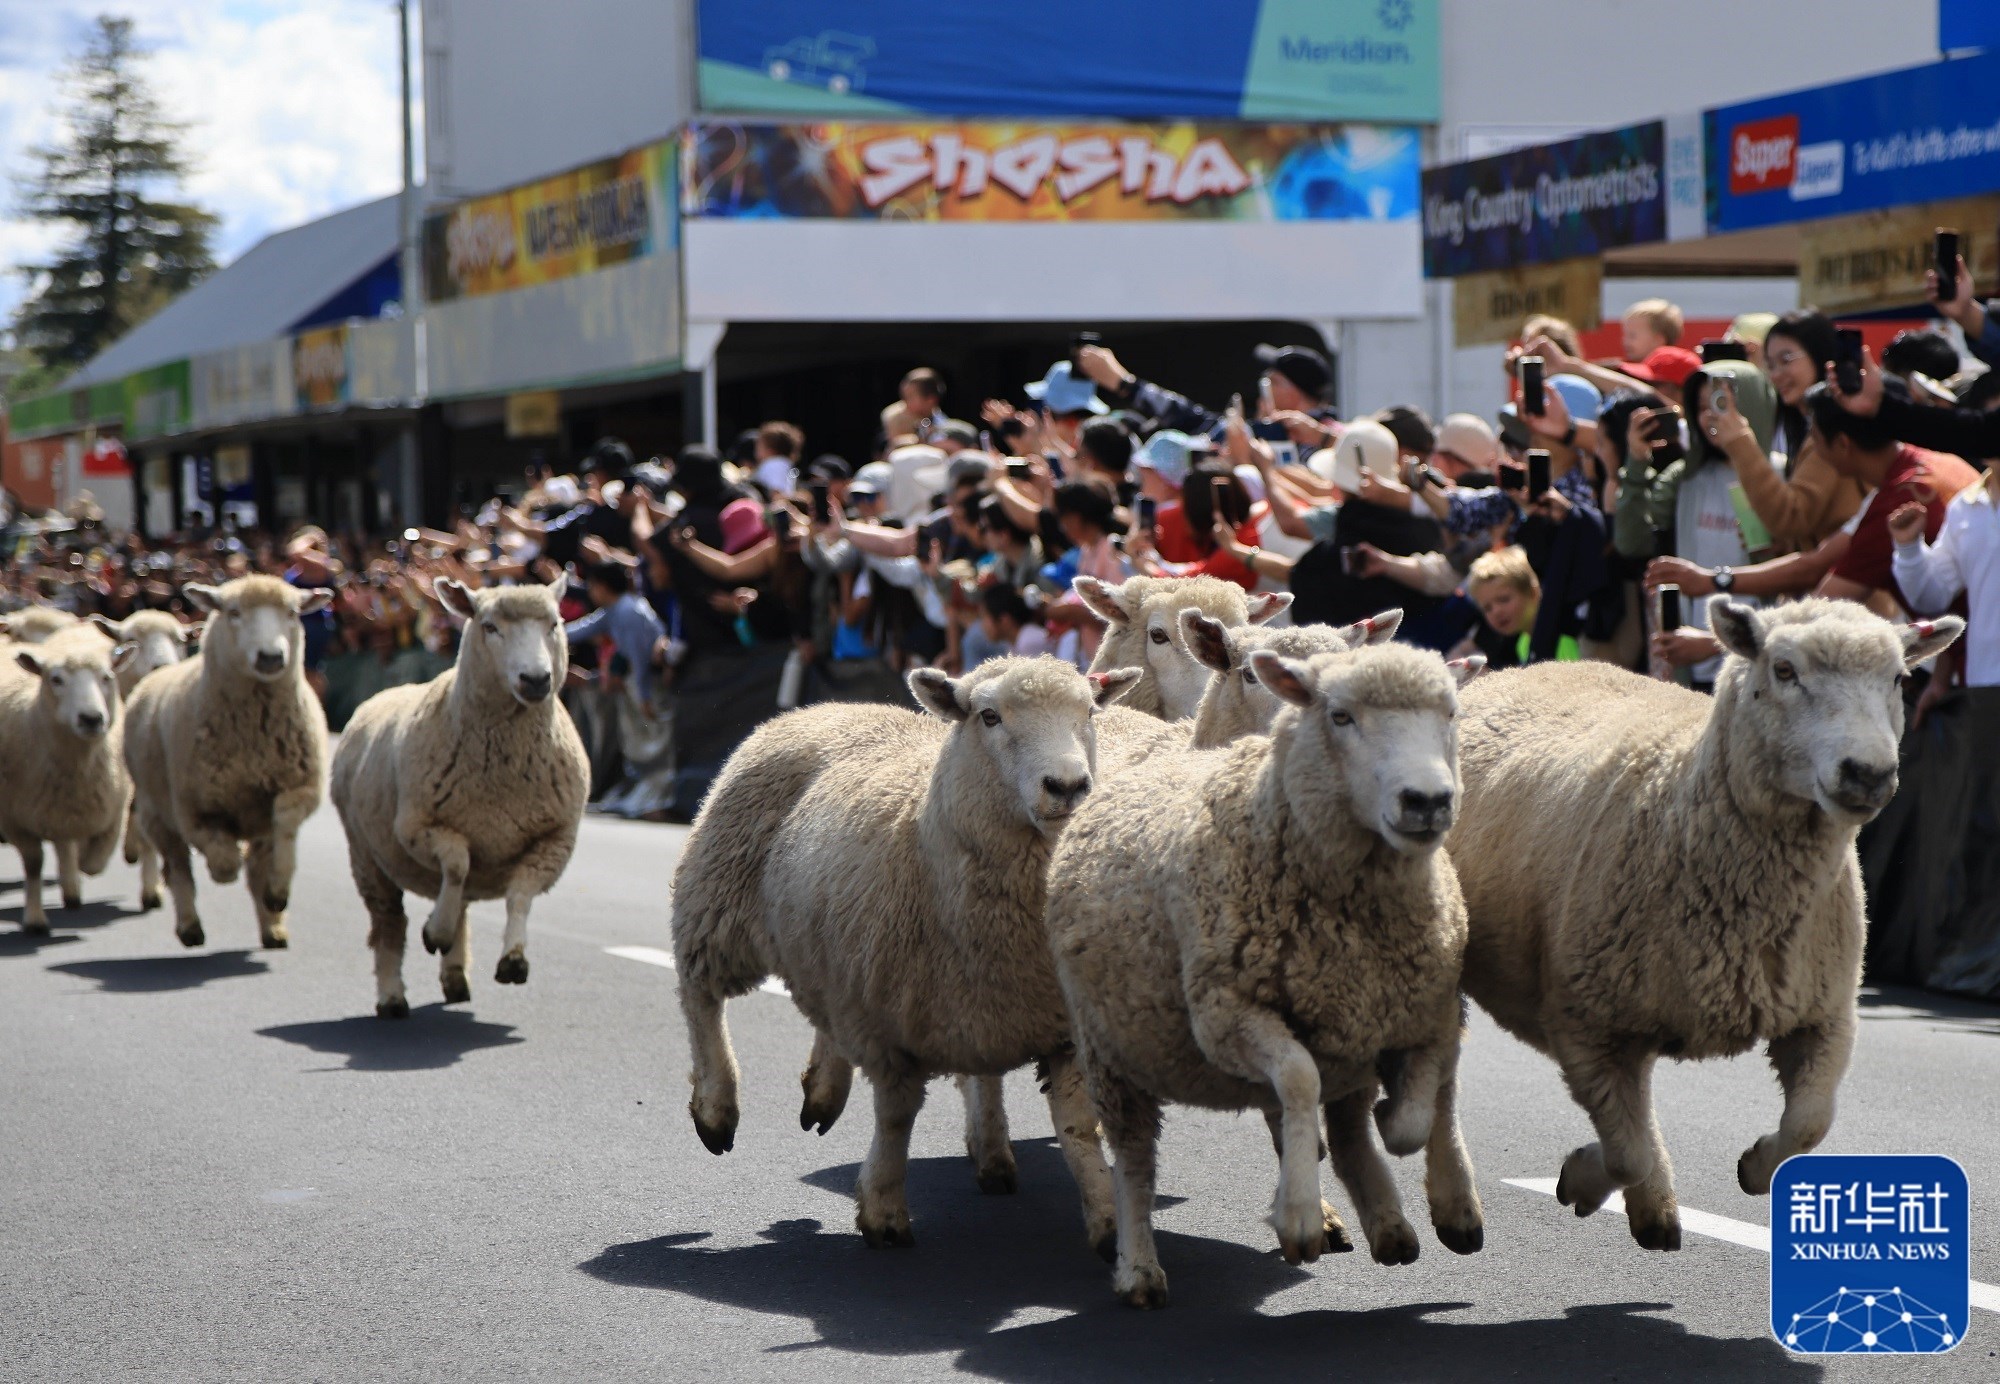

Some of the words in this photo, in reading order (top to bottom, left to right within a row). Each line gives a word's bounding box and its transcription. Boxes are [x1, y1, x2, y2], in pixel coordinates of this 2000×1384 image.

[1734, 132, 1795, 183] Super
[1425, 193, 1465, 246] King
[1464, 185, 1533, 233] Country
[1535, 156, 1659, 227] Optometrists
